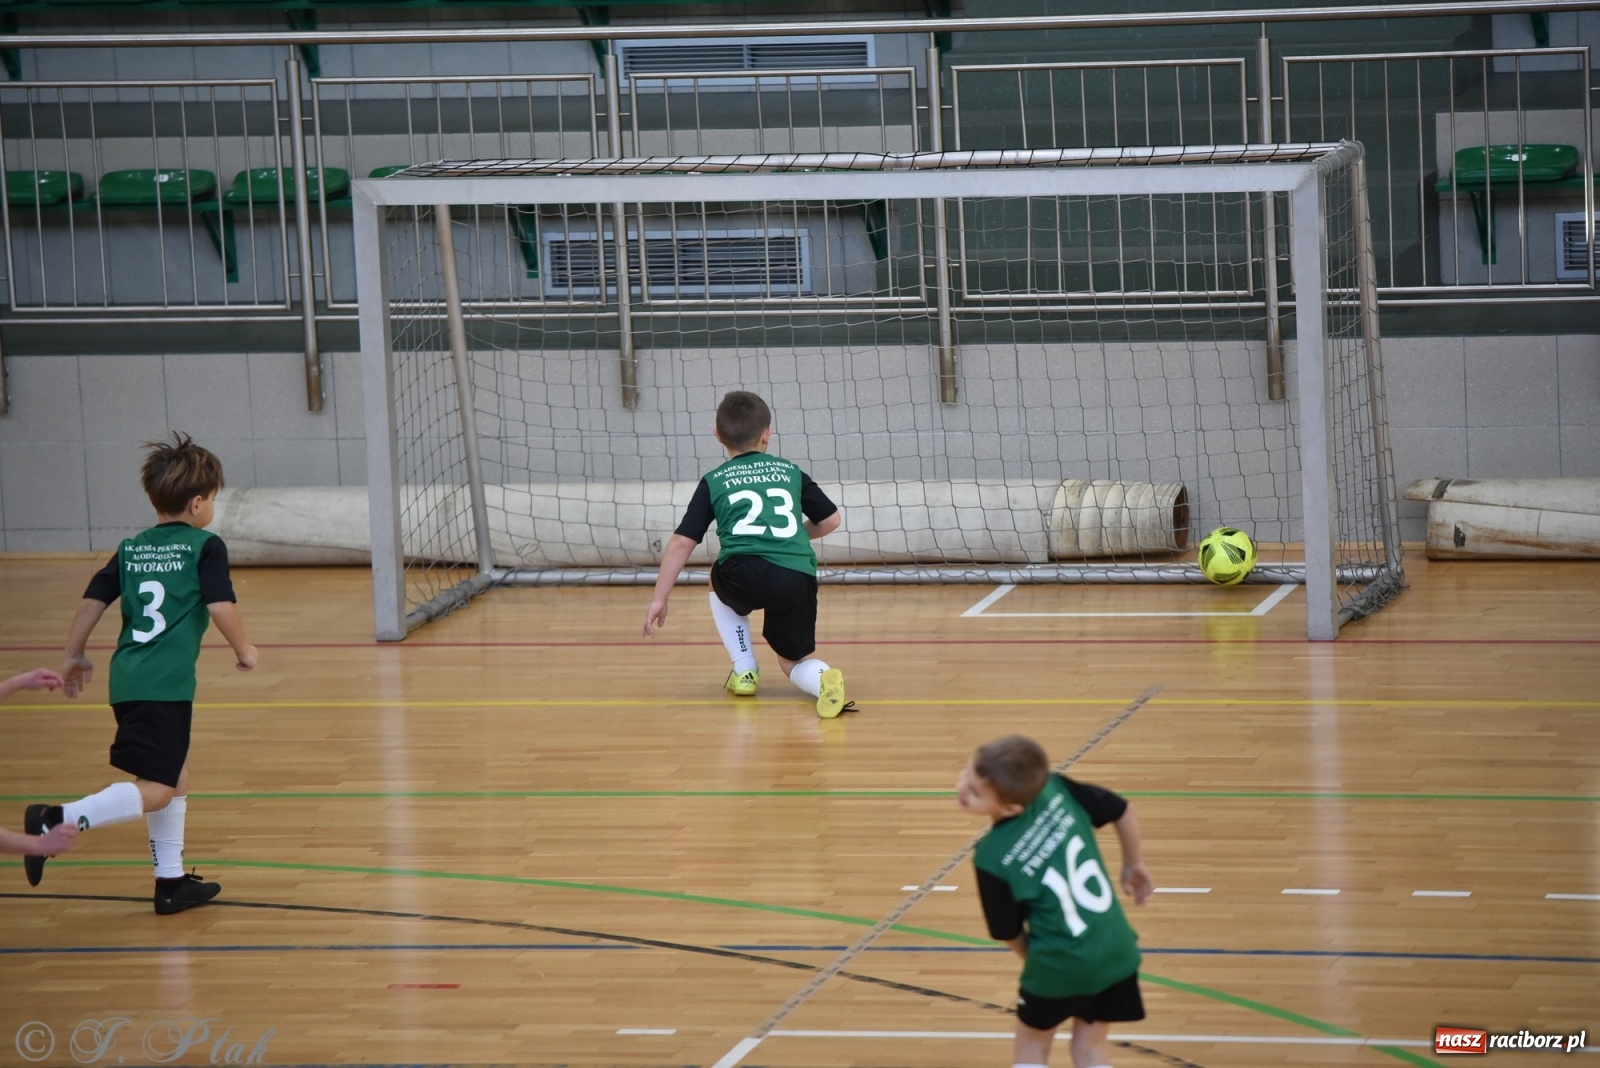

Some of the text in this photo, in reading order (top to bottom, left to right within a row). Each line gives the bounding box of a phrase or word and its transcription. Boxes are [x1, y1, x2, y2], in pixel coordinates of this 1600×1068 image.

[713, 463, 753, 479] AKADEMIA
[722, 471, 791, 489] TWORKÓW
[727, 488, 798, 538] 23
[125, 559, 185, 572] TWORKÓW
[132, 580, 166, 643] 3
[1041, 834, 1113, 938] 16
